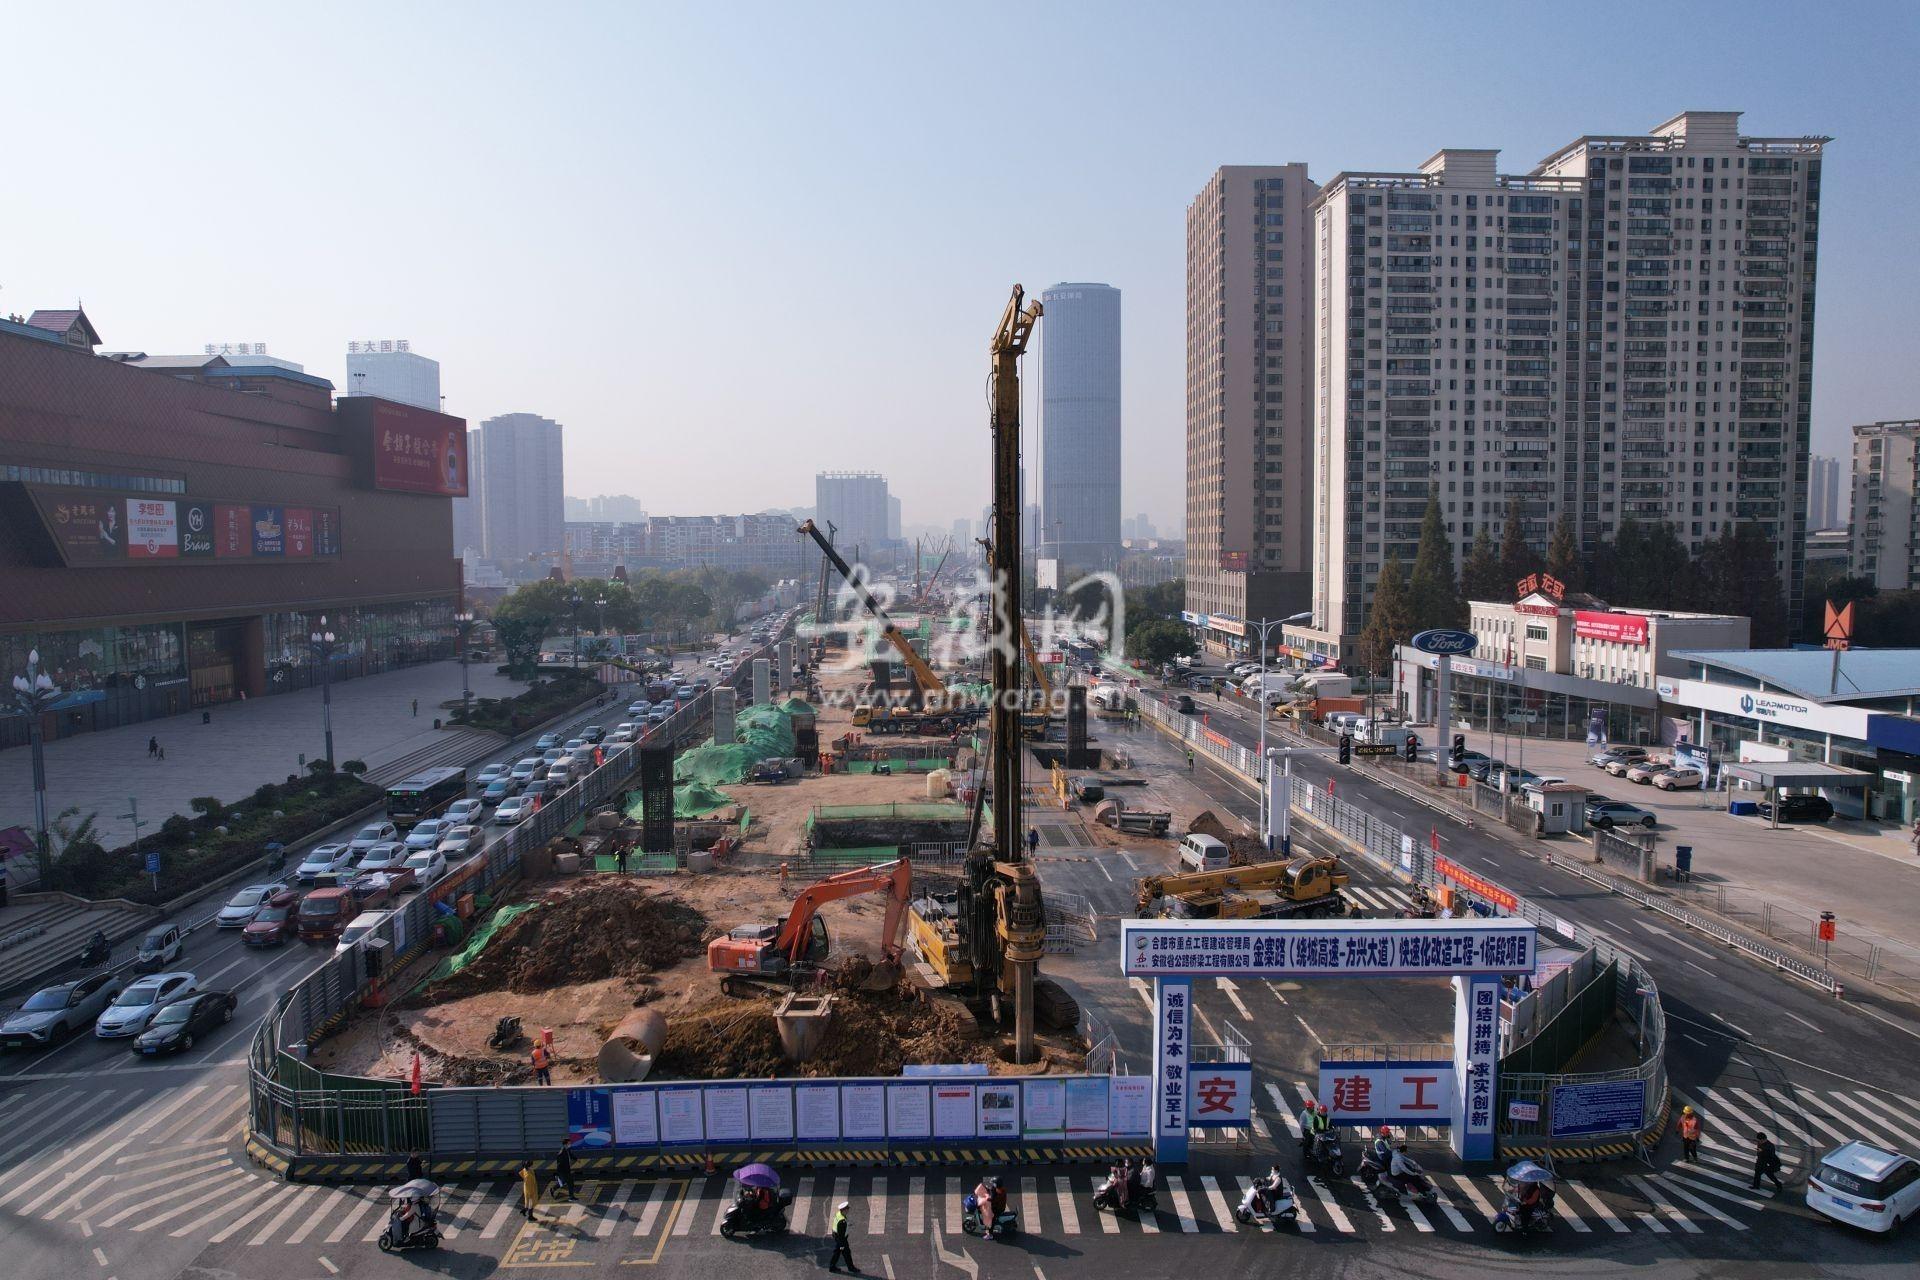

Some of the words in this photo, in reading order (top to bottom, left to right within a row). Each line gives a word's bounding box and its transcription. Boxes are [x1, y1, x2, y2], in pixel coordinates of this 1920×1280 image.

[205, 342, 266, 356] 丰大集团
[348, 339, 410, 353] 丰大国际
[192, 514, 203, 526] YH
[184, 533, 211, 551] Bravo
[1428, 633, 1465, 650] Ford
[1823, 638, 1849, 651] JMC
[1755, 699, 1808, 714] LEAPMOTOR
[1152, 937, 1250, 950] 合肥市重点工程建设管理局
[1152, 953, 1250, 968] 安徽省公路桥梁工程有限公司
[1166, 992, 1184, 1057] 诚信为本
[1474, 990, 1493, 1055] 团结拼搏
[1165, 1065, 1183, 1129] 敬业至上
[1197, 1077, 1237, 1114] 安
[1471, 1062, 1490, 1127] 求实创新
